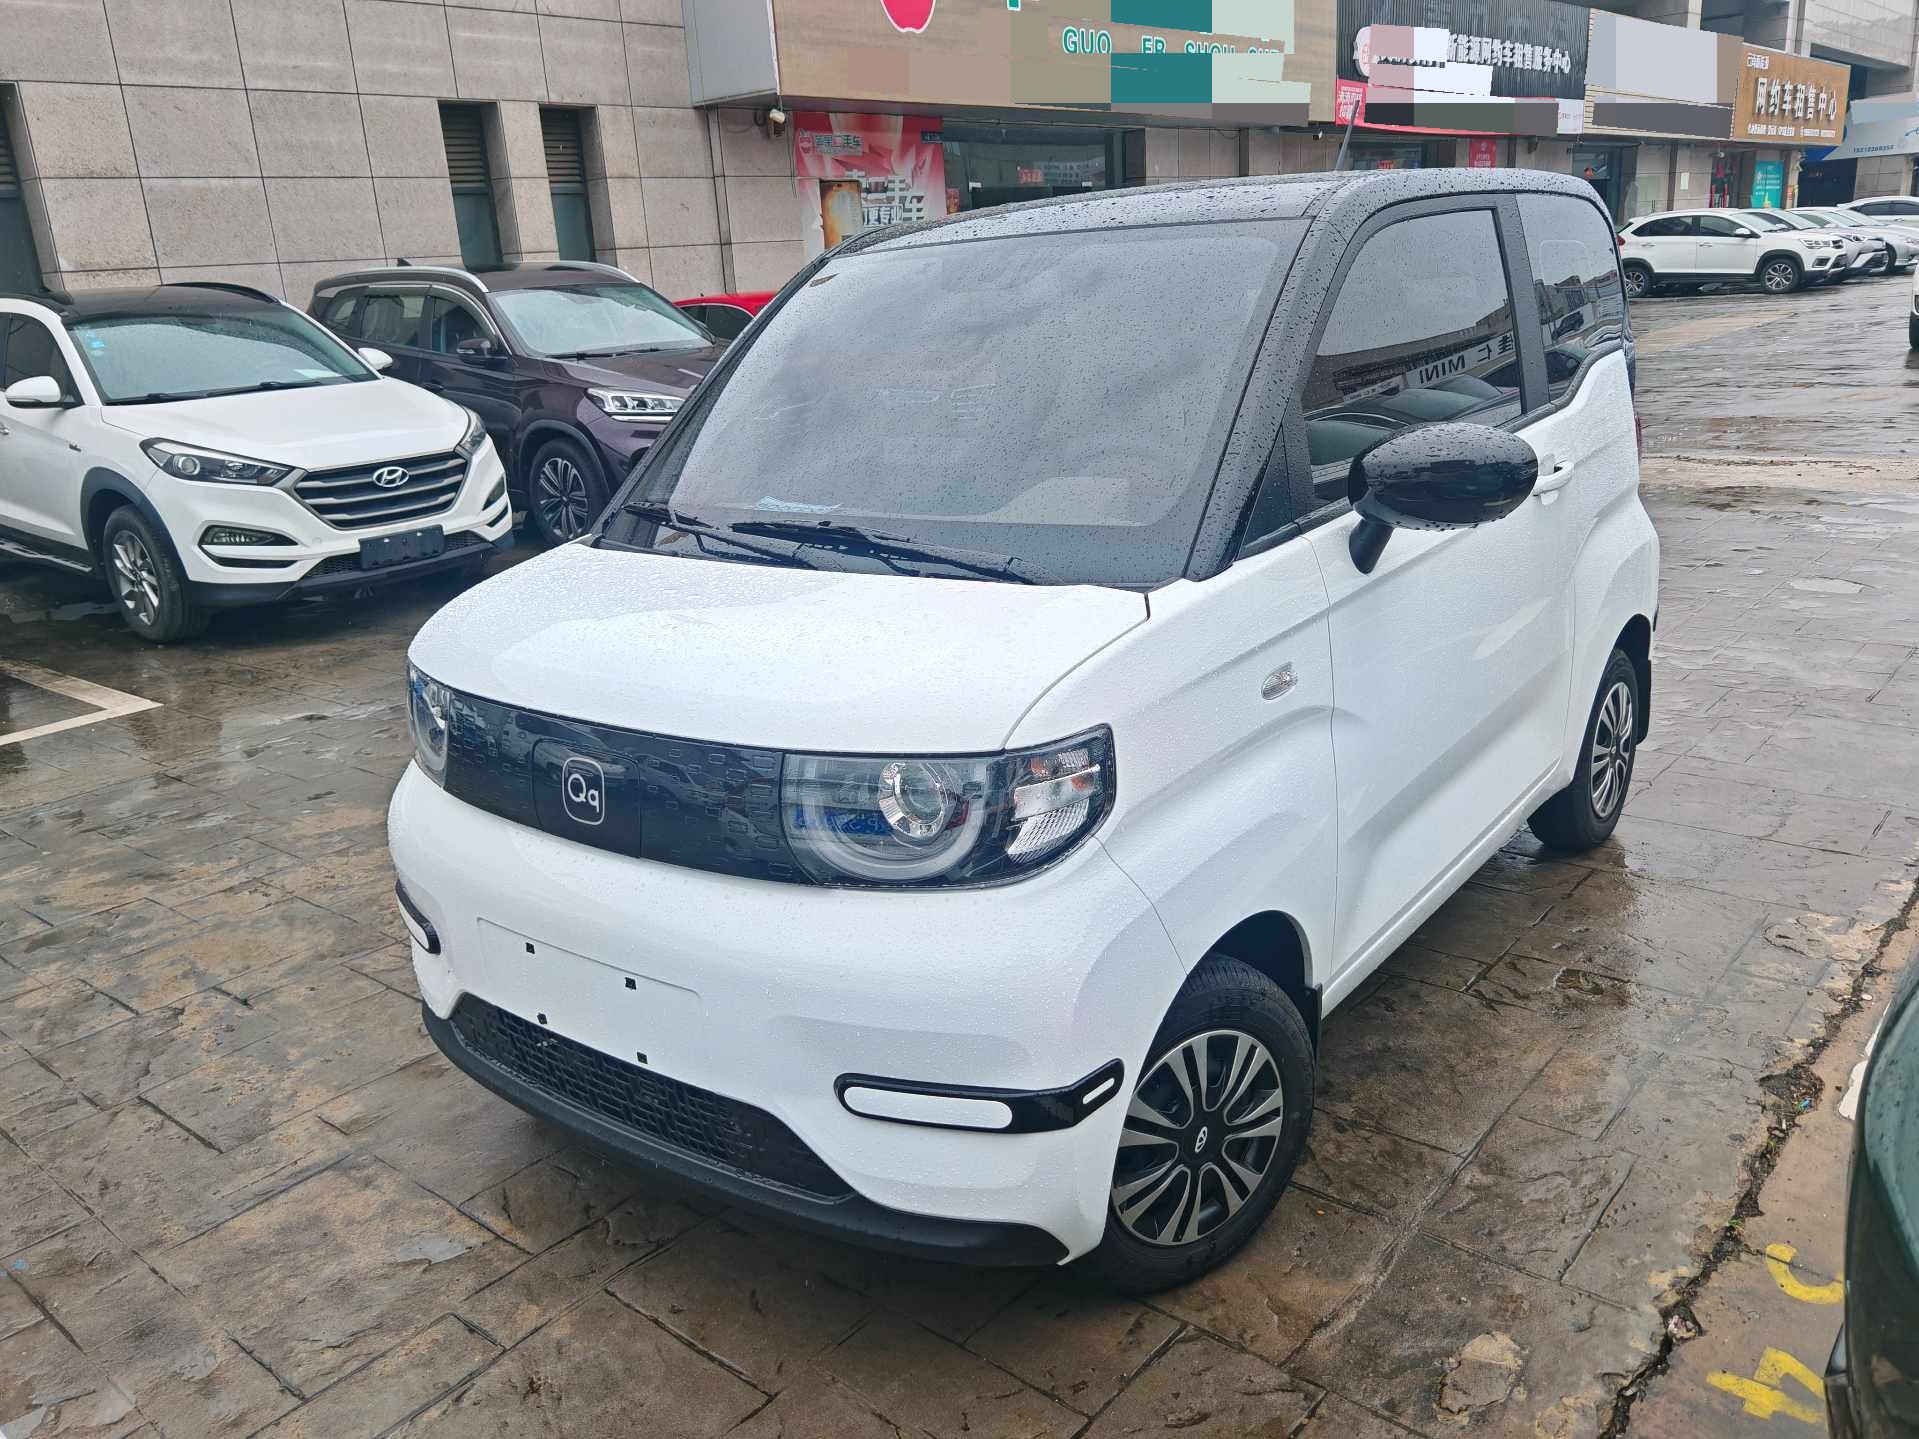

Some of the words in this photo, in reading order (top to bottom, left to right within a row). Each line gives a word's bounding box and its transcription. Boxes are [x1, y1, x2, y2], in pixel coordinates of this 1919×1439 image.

[1062, 26, 1112, 53] GUO
[1754, 77, 1838, 121] 网约车租售中心
